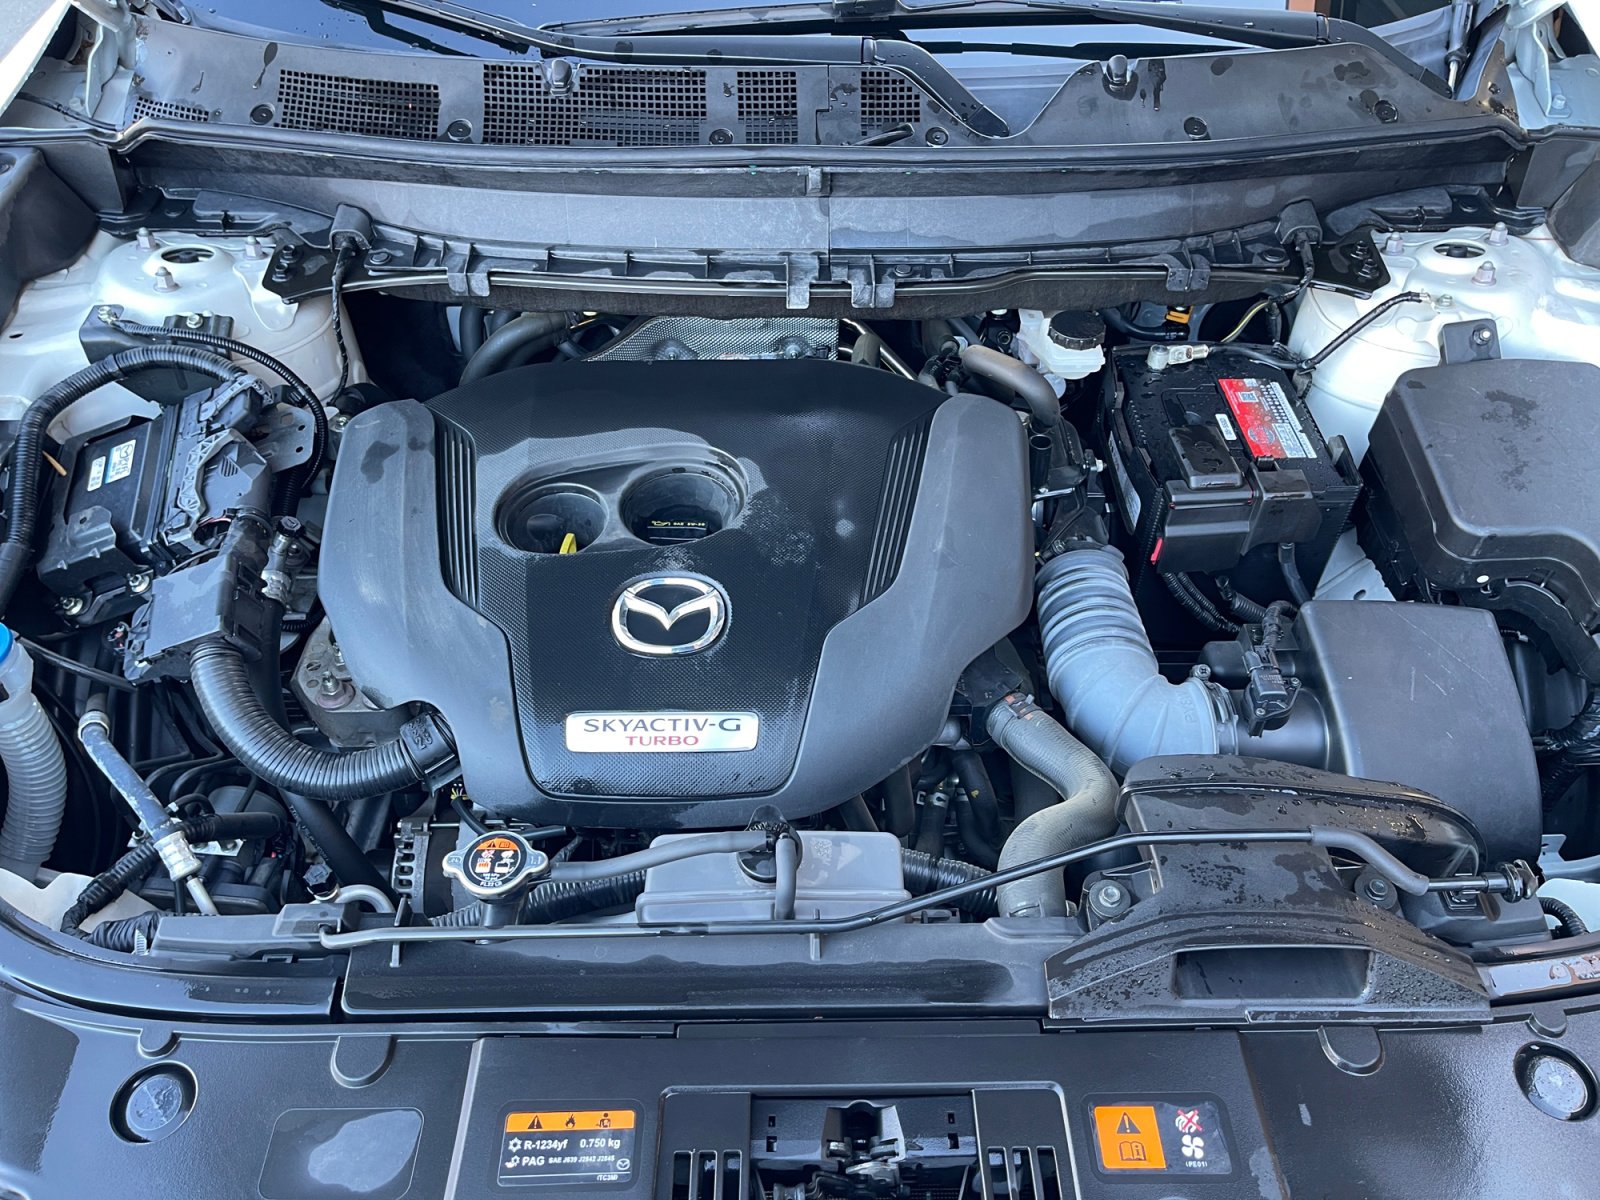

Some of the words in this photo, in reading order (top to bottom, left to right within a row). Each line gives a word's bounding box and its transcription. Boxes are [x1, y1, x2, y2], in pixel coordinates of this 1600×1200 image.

[583, 717, 742, 733] SKYACTIV-G
[625, 735, 699, 746] TURBO
[523, 1138, 568, 1151] R-1234yf
[579, 1138, 606, 1148] 0.750
[607, 1137, 621, 1149] kg
[522, 1156, 545, 1166] PAG
[1185, 1160, 1208, 1168] (PE01)
